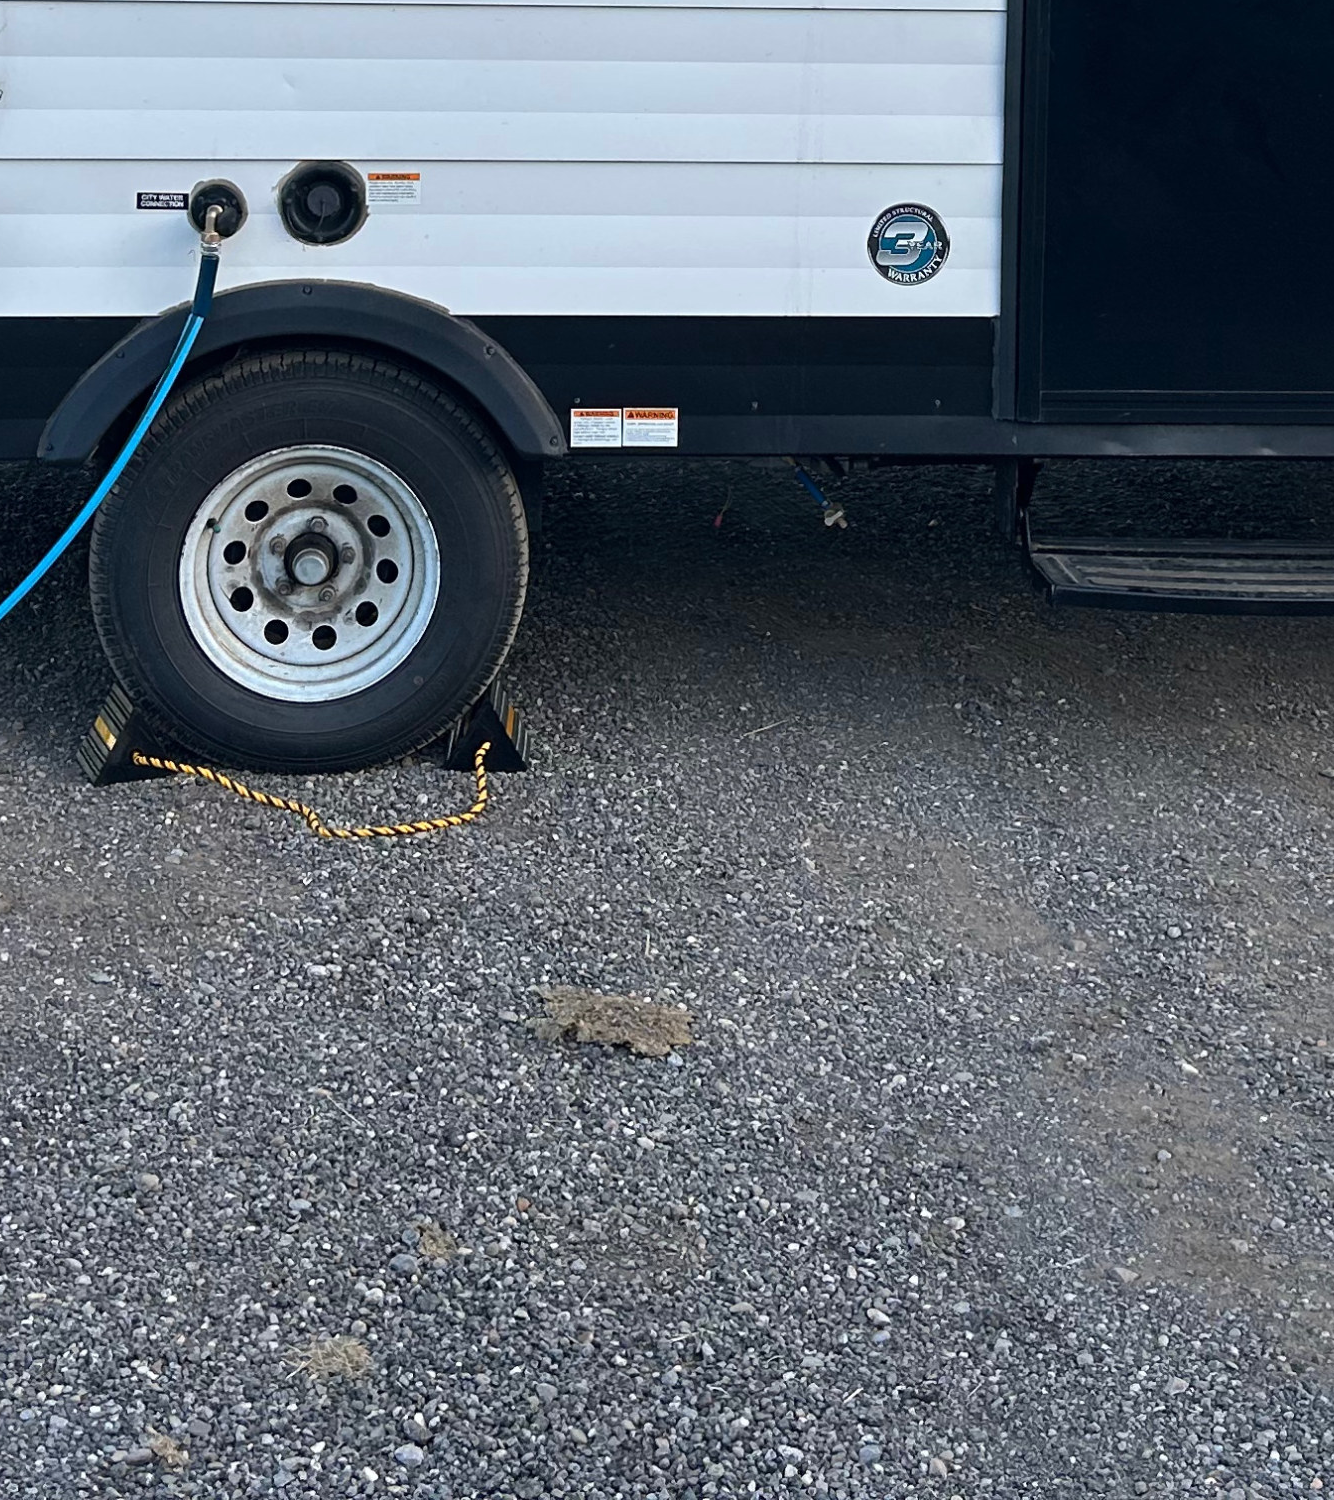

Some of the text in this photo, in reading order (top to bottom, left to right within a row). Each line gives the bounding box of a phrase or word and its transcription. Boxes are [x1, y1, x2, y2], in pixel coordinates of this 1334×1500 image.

[872, 207, 934, 238] LIMITED STRUCTURAL
[875, 221, 943, 266] 3 YEAR
[887, 254, 943, 282] WARRANTY
[635, 411, 674, 419] WARNING
